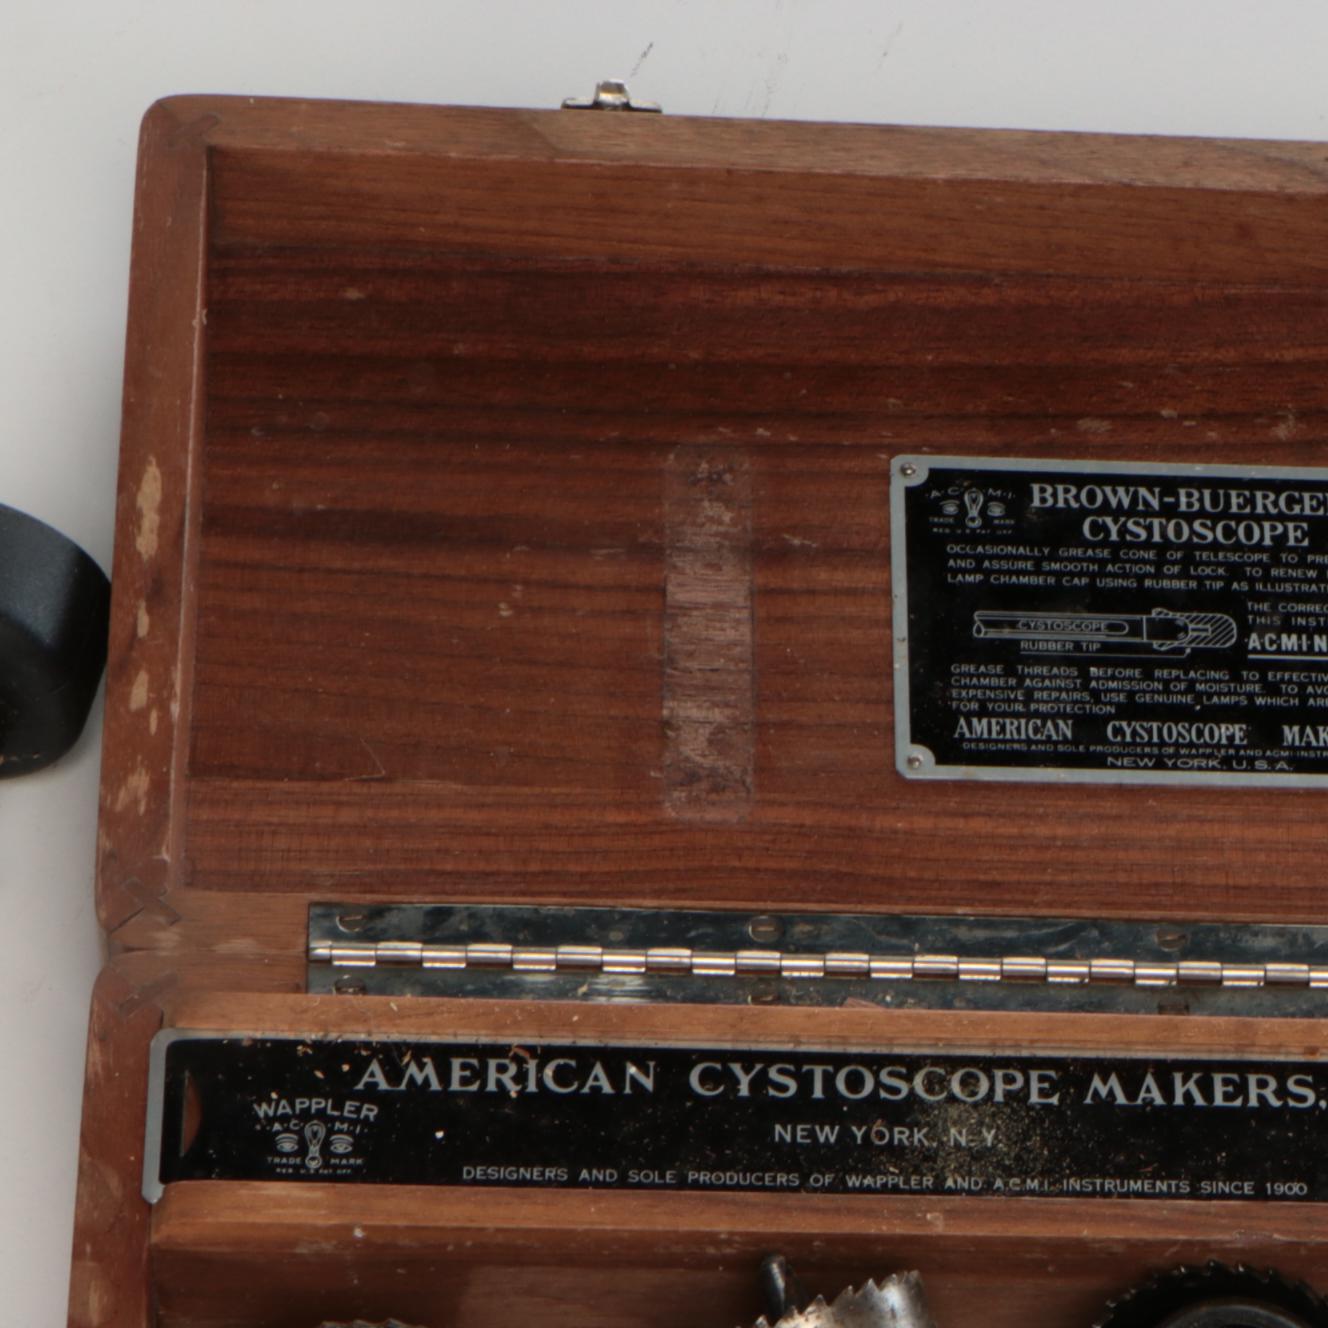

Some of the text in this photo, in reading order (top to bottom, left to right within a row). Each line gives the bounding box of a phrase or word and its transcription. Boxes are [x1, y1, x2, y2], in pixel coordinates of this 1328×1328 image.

[1082, 516, 1308, 545] CYSTOSCOPE
[946, 544, 1049, 555] OCCASIONALLY
[1058, 547, 1110, 557] GREASE
[1119, 549, 1156, 559] CONE
[1166, 550, 1183, 560] OF
[1194, 551, 1269, 562] TELESCOPE
[1280, 552, 1298, 563] TO
[947, 559, 975, 568] AND
[982, 559, 1034, 570] ASSURE
[1042, 561, 1098, 572] SMOOTH
[1105, 563, 1155, 573] ACTION
[1163, 564, 1181, 574] OF
[1245, 567, 1262, 577] TO
[1270, 568, 1317, 578] RENEW
[947, 573, 983, 582] LAMP
[990, 574, 1055, 585] CHAMBER
[1062, 576, 1089, 586] CAP
[1096, 578, 1137, 587] USING
[1144, 578, 1197, 589] RUBBER
[1204, 580, 1224, 589] TIP
[1231, 581, 1248, 591] AS
[1247, 601, 1270, 611] THE
[1017, 620, 1107, 634] CYSTOSCOPE
[1247, 615, 1280, 624] THIS
[1020, 640, 1100, 651] RUBBER TIP
[950, 664, 1003, 674] GREASE
[1017, 665, 1077, 675] THREADS
[1089, 667, 1141, 677] BEFORE
[1154, 669, 1229, 680] REPLACING
[1241, 671, 1259, 680] TO
[951, 676, 1016, 686] CHAMBER
[1023, 678, 1080, 688] AGAINST
[1089, 680, 1163, 690] ADMISSION
[1169, 681, 1186, 691] OF
[1280, 684, 1298, 693] TO
[952, 689, 1024, 699] EXPENSIVE
[1033, 691, 1093, 700] REPAIRS,
[1101, 692, 1126, 702] USE
[1135, 693, 1194, 703] GENUINE
[1203, 695, 1247, 705] LAMPS
[1254, 696, 1298, 706] WHICH
[952, 700, 1115, 713] FOR YOUR PROTECTION
[954, 717, 1072, 740] AMERICAN
[1106, 721, 1247, 744] CYSTOSCOPE
[1107, 757, 1155, 766] NEW
[356, 1054, 653, 1096] AMERICAN
[688, 1062, 1060, 1103] CYSTOSCOPE
[1084, 1070, 1327, 1109] MAKERS,
[252, 1097, 380, 1122] WAPPLER
[774, 1124, 839, 1143] NEW
[267, 1156, 365, 1166] TRADE MARK
[462, 1165, 567, 1180] DESIGNERS
[579, 1168, 617, 1181] AND
[628, 1169, 675, 1183] SOLE
[688, 1171, 799, 1186] PRODUCERS
[809, 1173, 834, 1187] OF
[845, 1173, 933, 1188] WAPPLER
[945, 1172, 983, 1189] AND
[1063, 1178, 1190, 1193] INSTRUMENTS
[1200, 1180, 1254, 1194] SINCE
[1266, 1181, 1307, 1195] 1900
